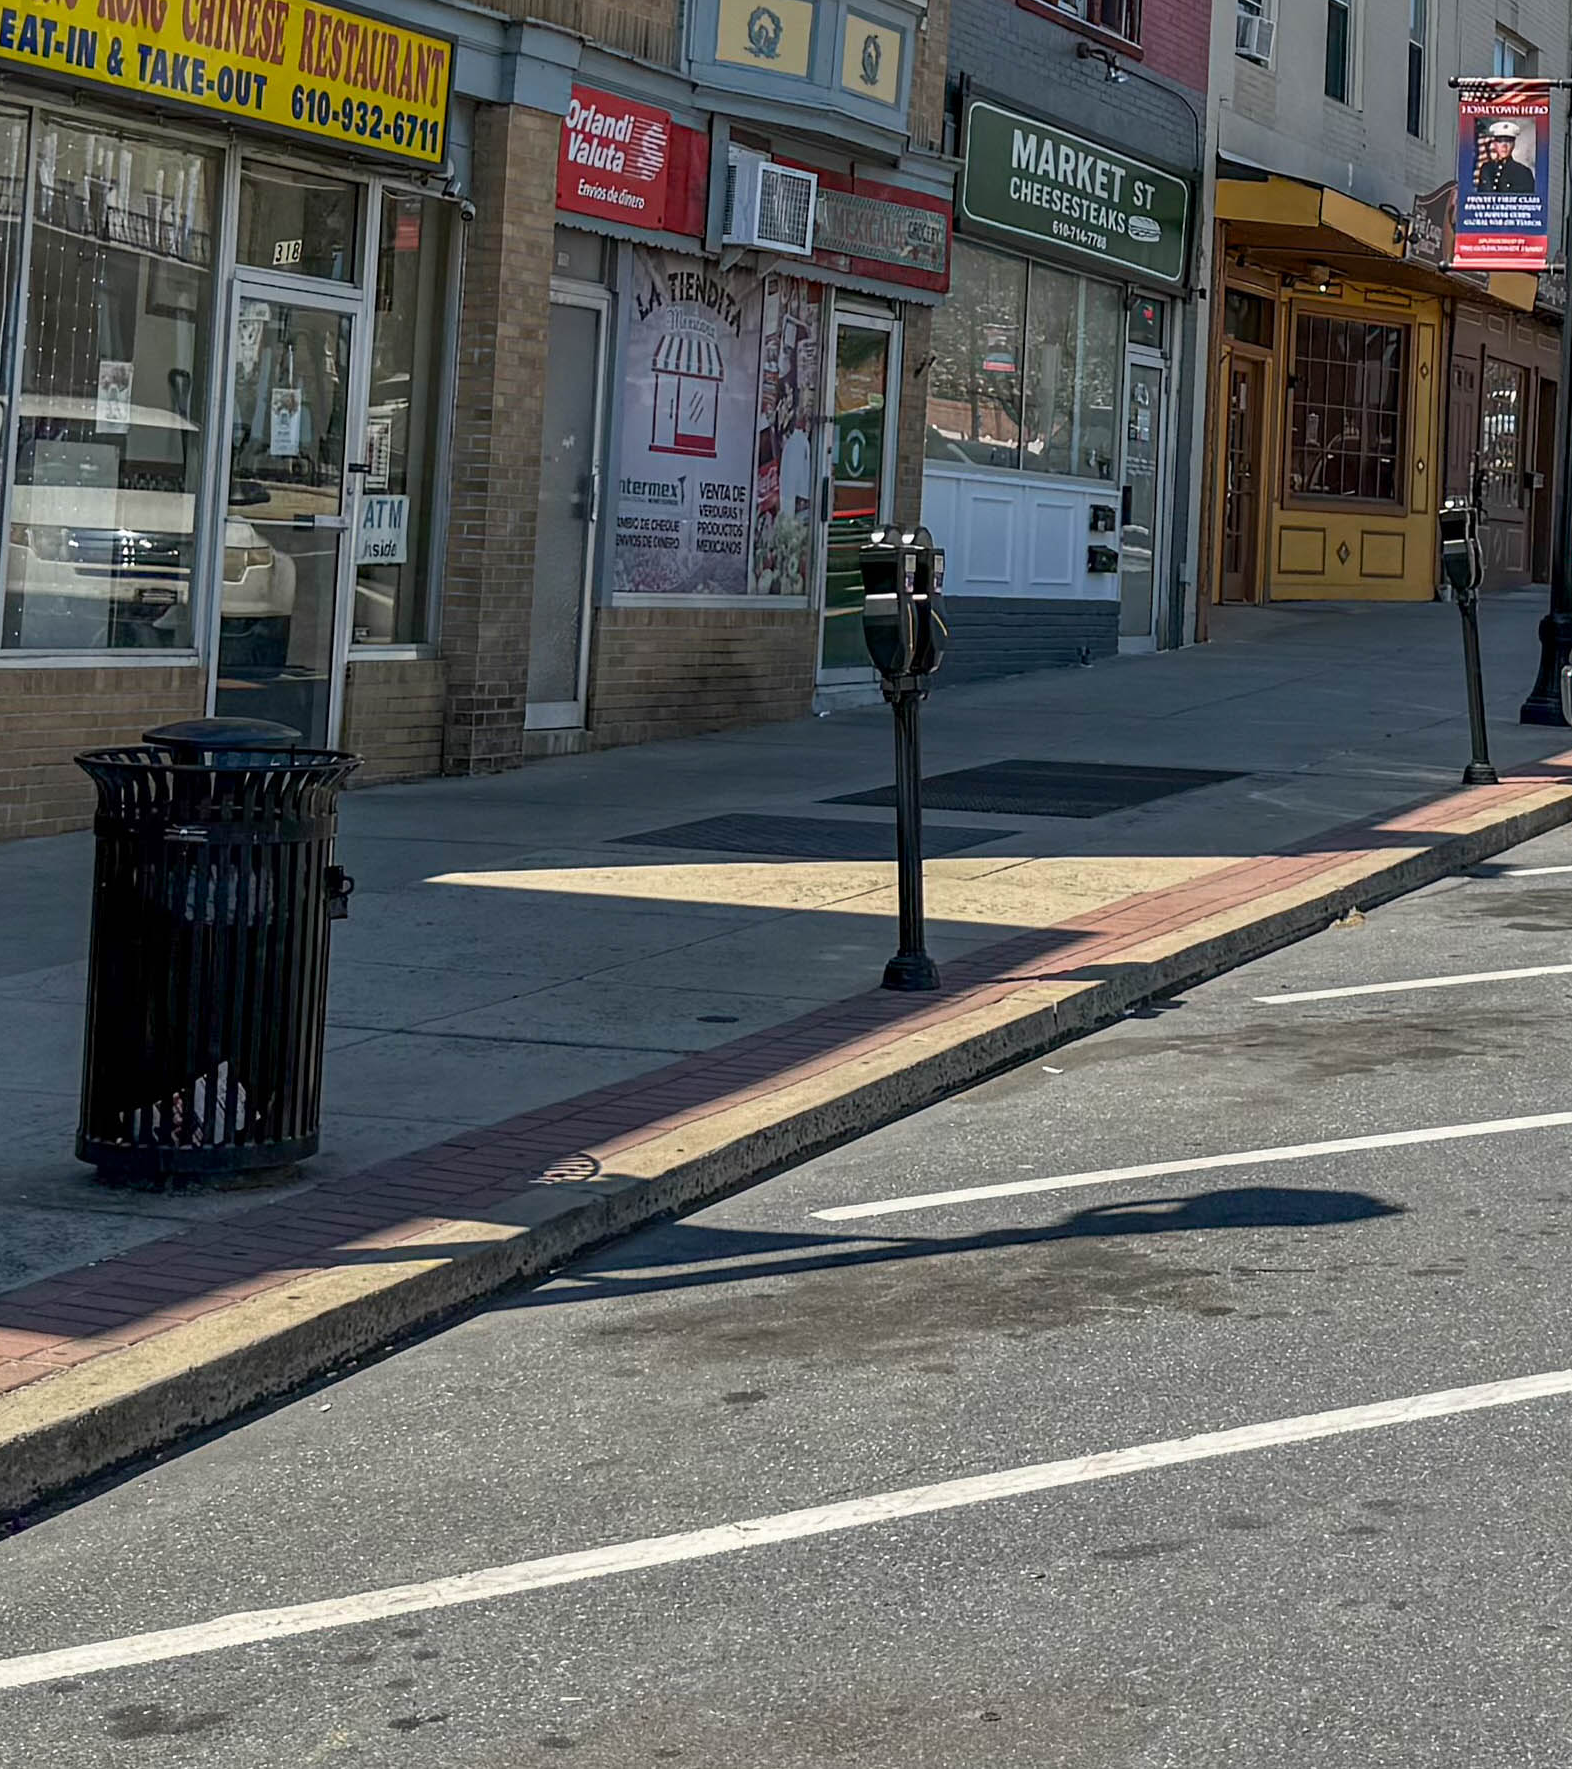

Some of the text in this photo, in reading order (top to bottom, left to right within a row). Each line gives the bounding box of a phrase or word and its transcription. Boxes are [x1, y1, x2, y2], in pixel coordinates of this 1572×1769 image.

[298, 8, 445, 109] RESTAURANT
[107, 37, 125, 77] &
[137, 42, 268, 112] TAKE-OUT
[291, 83, 439, 154] 610-932-6711
[565, 99, 635, 144] Orlandi
[567, 131, 626, 174] Valuta
[1012, 129, 1155, 210] MARKET ST
[606, 185, 619, 204] de
[618, 188, 645, 210] dinero
[1010, 176, 1126, 234] CHEESESTEAKS
[276, 242, 300, 262] 318
[636, 272, 741, 338] LA TIENDITA
[619, 478, 678, 498] ntermex
[699, 482, 731, 501] VENTA
[732, 486, 747, 502] DE
[363, 500, 403, 529] ATM
[696, 539, 742, 556] MEXICANOS
